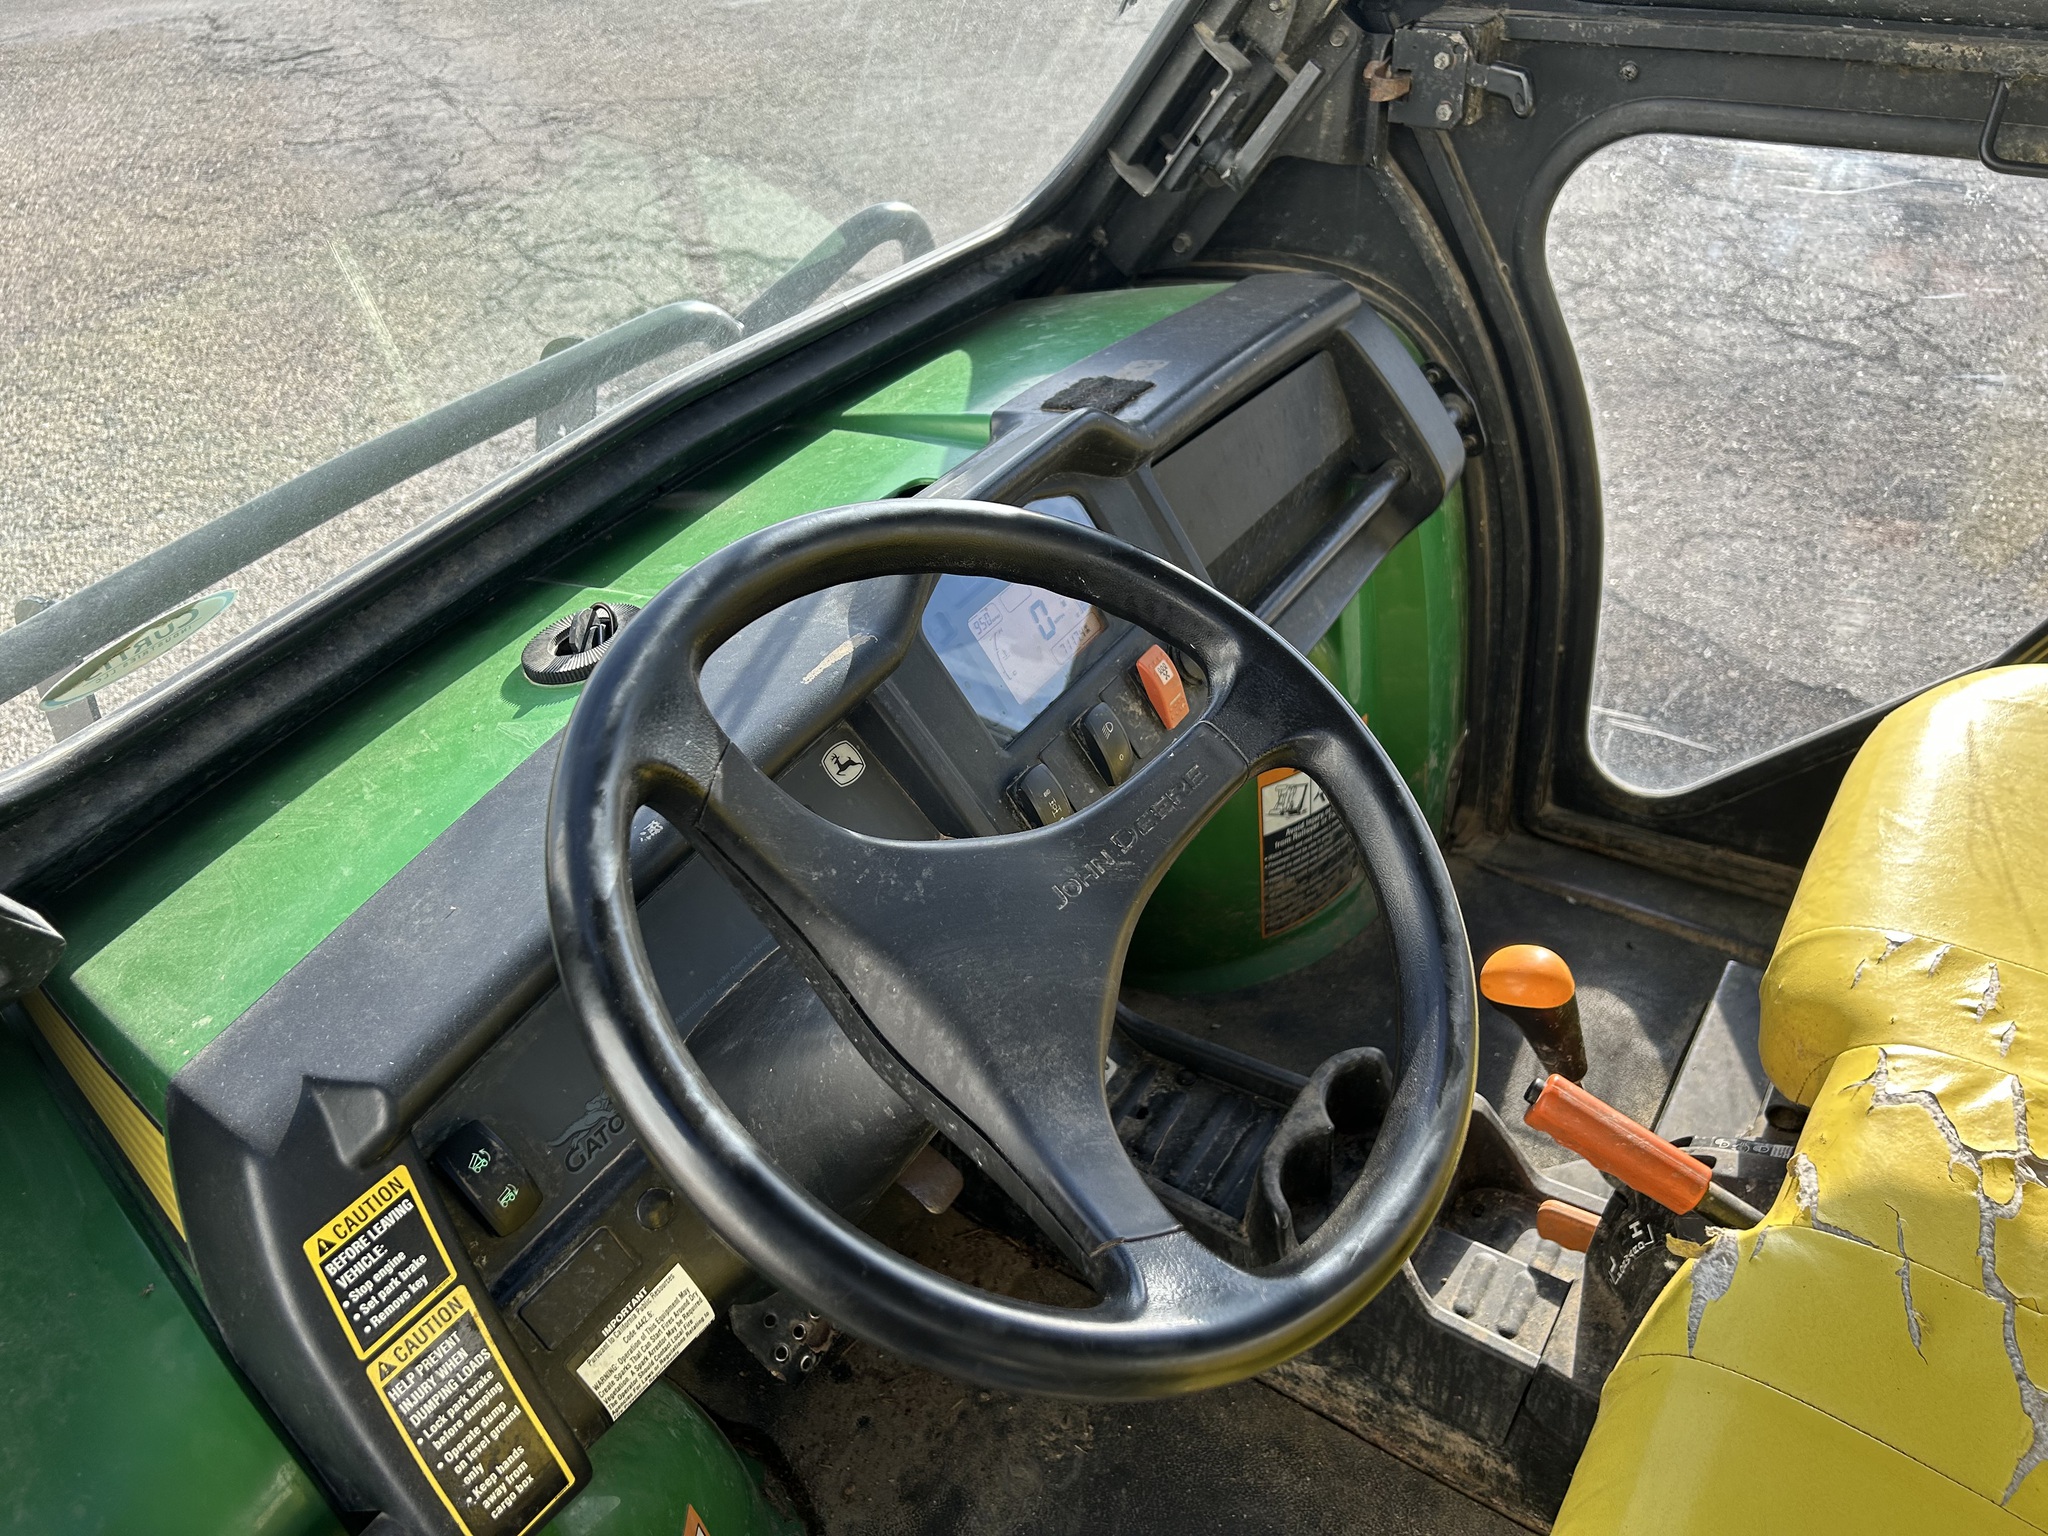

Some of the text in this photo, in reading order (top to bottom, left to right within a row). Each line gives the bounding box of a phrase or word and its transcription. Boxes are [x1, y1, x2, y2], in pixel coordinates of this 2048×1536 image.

[1051, 764, 1209, 910] JOHN DEERE
[564, 1114, 625, 1173] GATO
[324, 1198, 414, 1276] BEFORE LEAVING
[332, 1176, 404, 1239] CAUTION
[1629, 1221, 1643, 1239] H
[335, 1244, 388, 1288] VEHICLE:
[347, 1251, 406, 1303] Stop engine
[358, 1254, 427, 1315] Set park brake
[369, 1290, 410, 1328] Remove
[407, 1274, 428, 1294] key
[393, 1295, 463, 1362] CAUTION
[586, 1273, 675, 1367] Pursuant to California Public Resources
[601, 1286, 648, 1337] IMPORTANT
[387, 1330, 460, 1402] HELP PREVENT
[592, 1287, 690, 1391] WARNING: Operation of This Equipment May
[597, 1290, 699, 1398] Create Sparks That Can Start Fires Around Dry
[621, 1329, 637, 1344] Code
[633, 1355, 649, 1372] Spark
[647, 1335, 667, 1357] Arrestor
[665, 1325, 677, 1338] May
[675, 1318, 683, 1327] be
[398, 1346, 468, 1414] INJURY WHEN
[409, 1347, 491, 1427] DUMPING LOADS
[607, 1399, 618, 1410] The
[616, 1377, 638, 1401] Operator
[636, 1359, 655, 1379] Should
[653, 1341, 672, 1362] Contact
[669, 1327, 684, 1344] Local
[422, 1370, 494, 1439] Lock park brake
[431, 1381, 504, 1450] before dumping
[443, 1401, 506, 1463] Operate dump
[453, 1404, 521, 1474] on level ground
[462, 1462, 484, 1485] only
[471, 1445, 524, 1499] Keep hands
[481, 1460, 528, 1509] away from
[490, 1473, 534, 1519] cargo box
